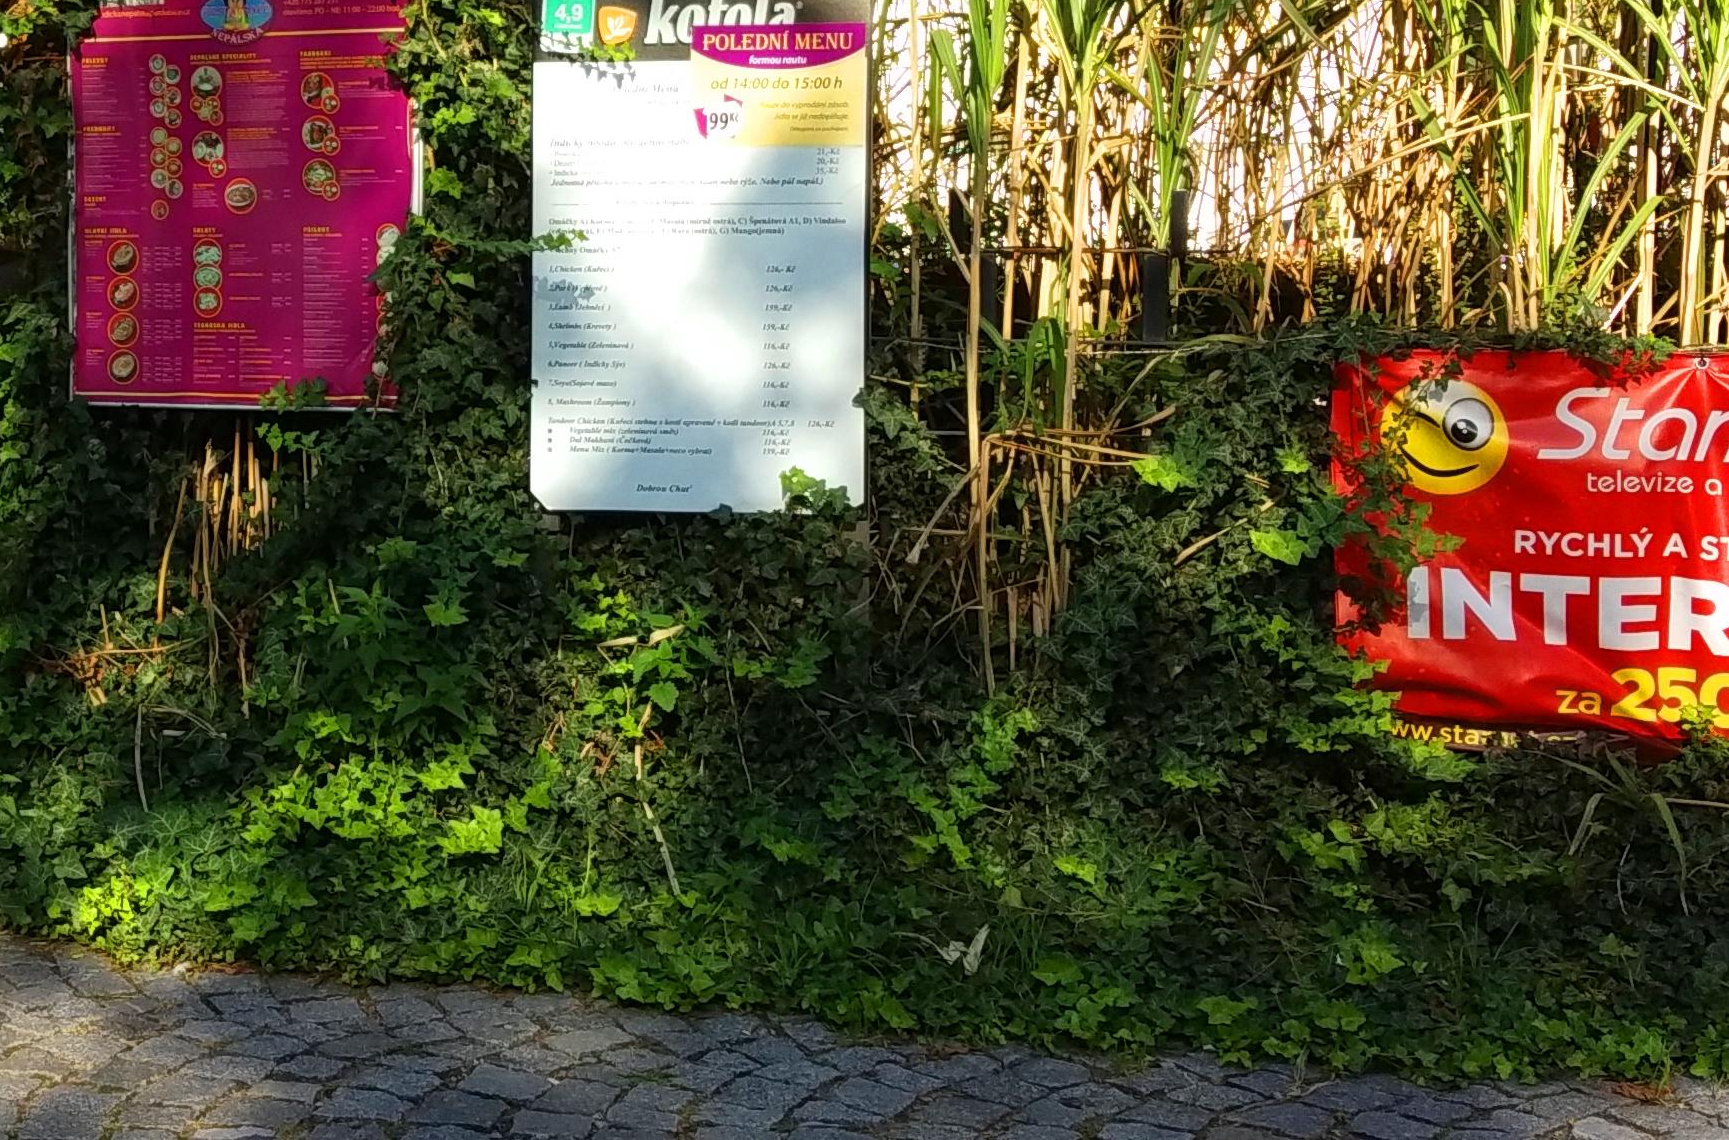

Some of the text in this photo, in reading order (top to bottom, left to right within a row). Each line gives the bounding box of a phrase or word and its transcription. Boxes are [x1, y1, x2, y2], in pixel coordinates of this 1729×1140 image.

[702, 30, 853, 51] POLEDNÍ MENU
[749, 55, 807, 65] formou rautu
[711, 76, 843, 89] od 14:00 do 15:00 h
[709, 112, 729, 130] 99
[1537, 387, 1729, 463] Star
[1587, 469, 1723, 496] televize a
[1514, 527, 1654, 558] RYCHLÝ
[1662, 532, 1689, 558] A
[1407, 566, 1729, 657] INTER
[1556, 690, 1602, 716] za
